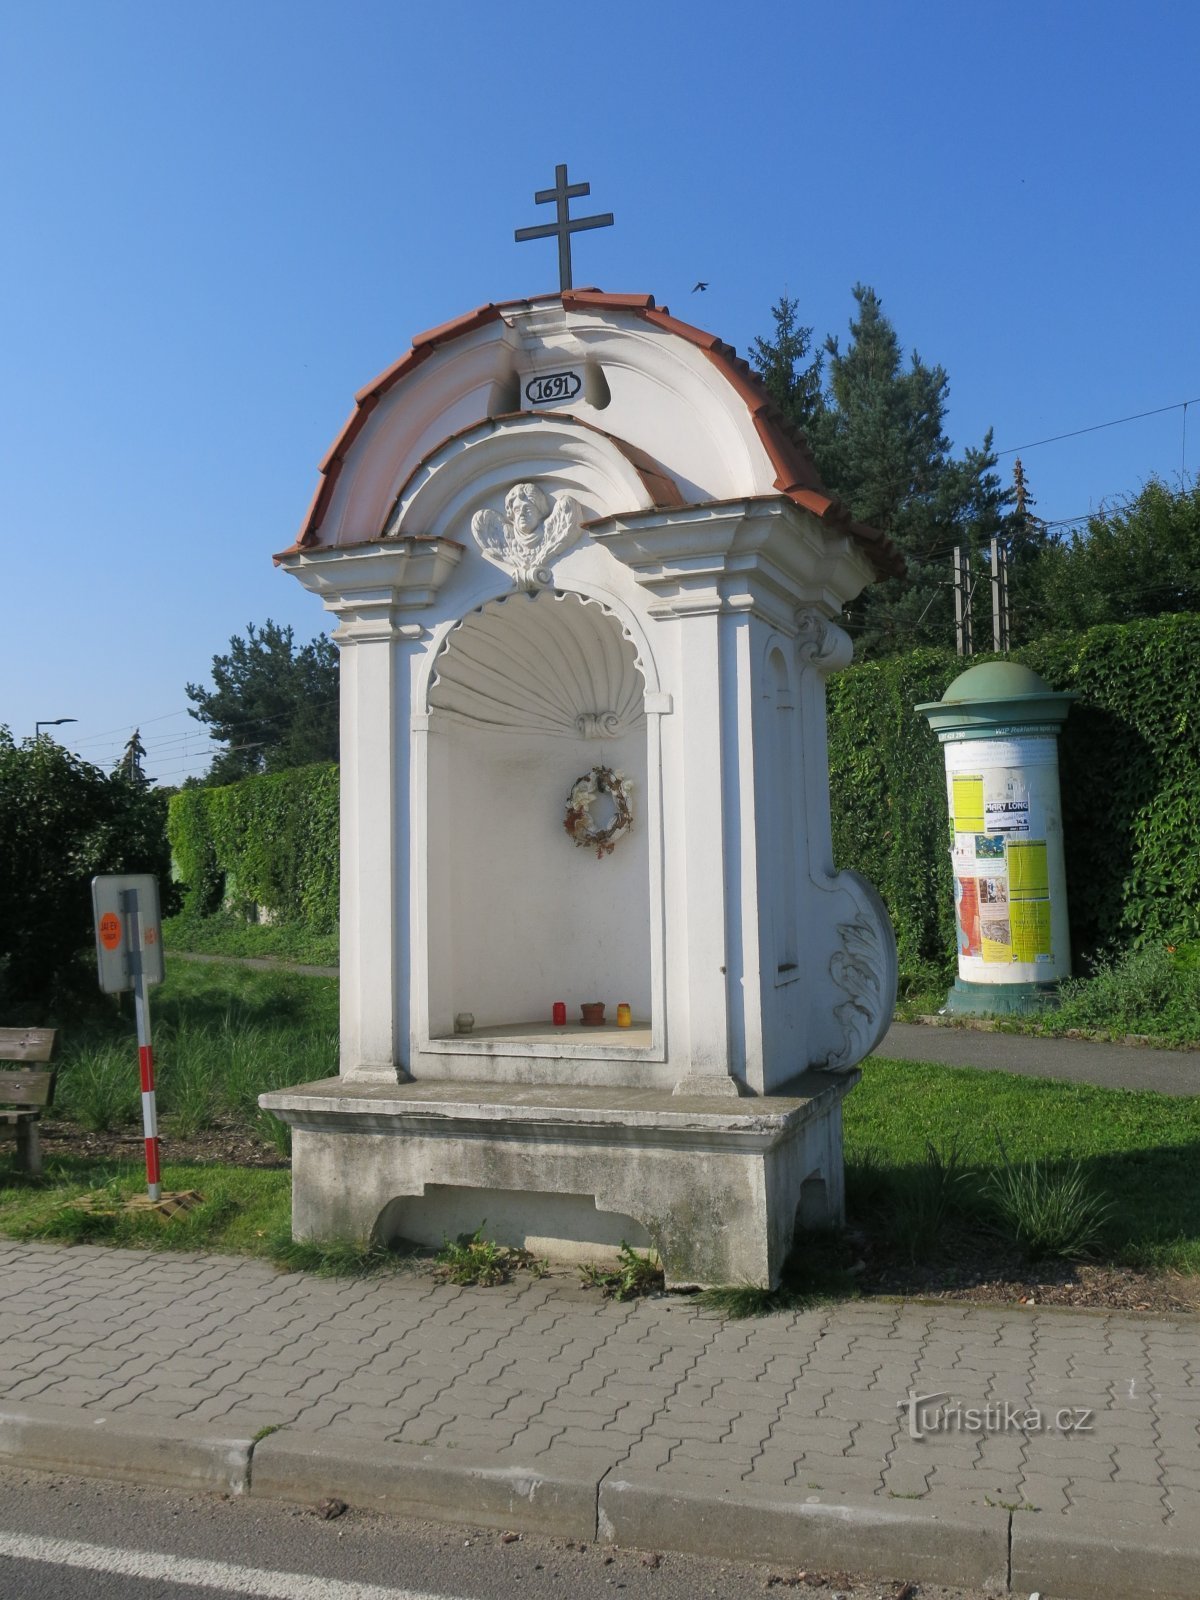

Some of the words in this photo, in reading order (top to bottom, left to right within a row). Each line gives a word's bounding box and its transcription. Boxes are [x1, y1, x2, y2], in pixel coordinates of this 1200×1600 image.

[536, 377, 570, 399] 1691
[1010, 725, 1039, 734] Reklama
[985, 803, 1007, 811] MARY
[1008, 801, 1028, 810] LONG
